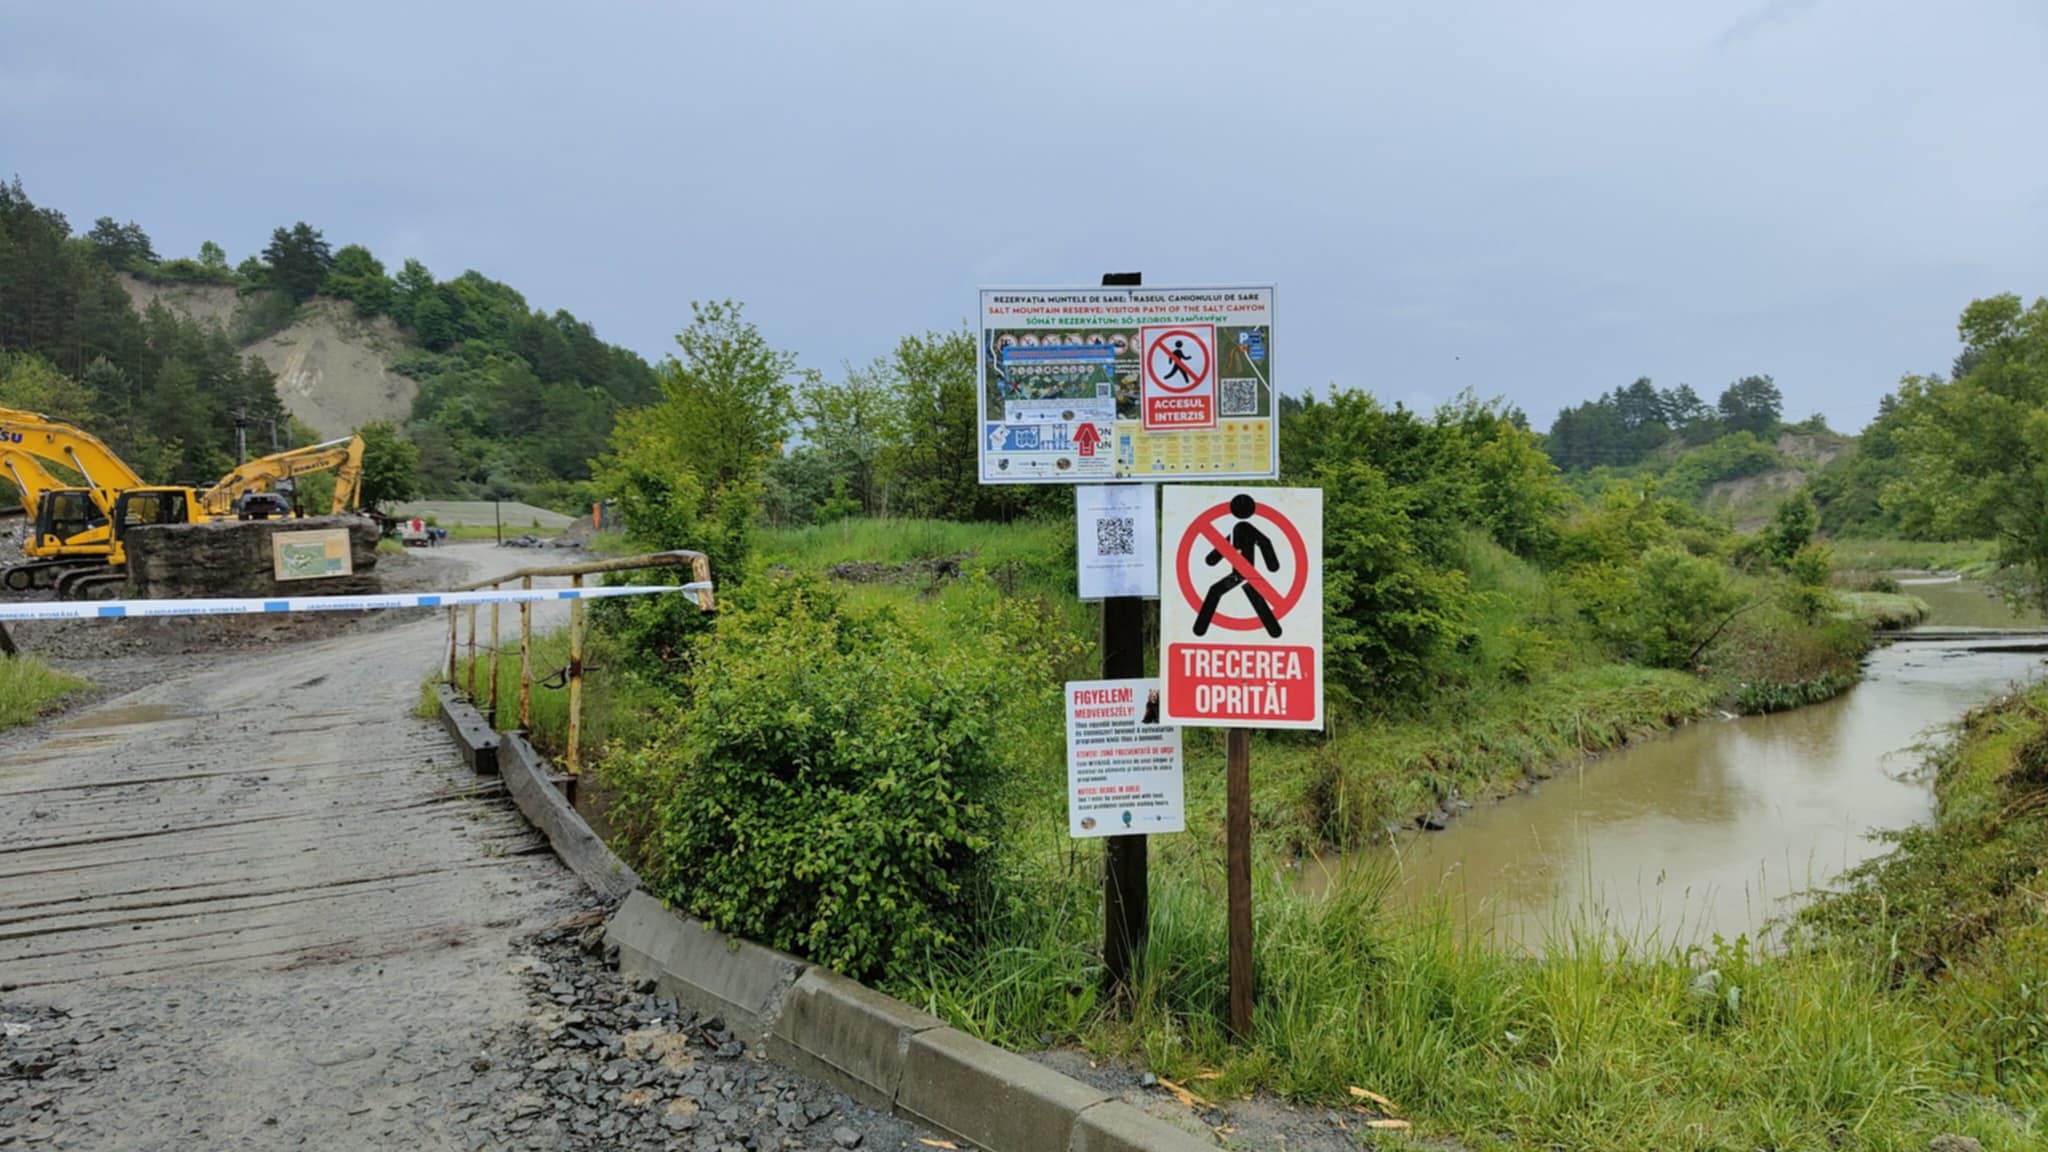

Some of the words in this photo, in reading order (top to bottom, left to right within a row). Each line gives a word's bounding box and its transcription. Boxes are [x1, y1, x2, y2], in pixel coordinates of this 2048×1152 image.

[1129, 295, 1165, 303] TRASEUL
[1168, 294, 1222, 302] CANIONULUI
[1238, 293, 1259, 301] SARE
[989, 306, 1009, 314] SALT
[1012, 306, 1060, 314] MOUNTAIN
[1106, 306, 1140, 314] VISITOR
[1143, 305, 1166, 313] PATH
[1168, 305, 1180, 313] OF
[1183, 305, 1200, 313] THE
[1202, 304, 1223, 312] SALT
[1226, 304, 1265, 312] CANYON
[1154, 398, 1205, 409] ACCESUL
[1154, 411, 1205, 421] INTERZIS
[1180, 649, 1303, 680] TRECEREA
[1073, 687, 1133, 705] FIGYELEM!
[1195, 681, 1288, 715] OPRITĂ!
[1074, 705, 1135, 719] MEDVEVESZÉLY!
